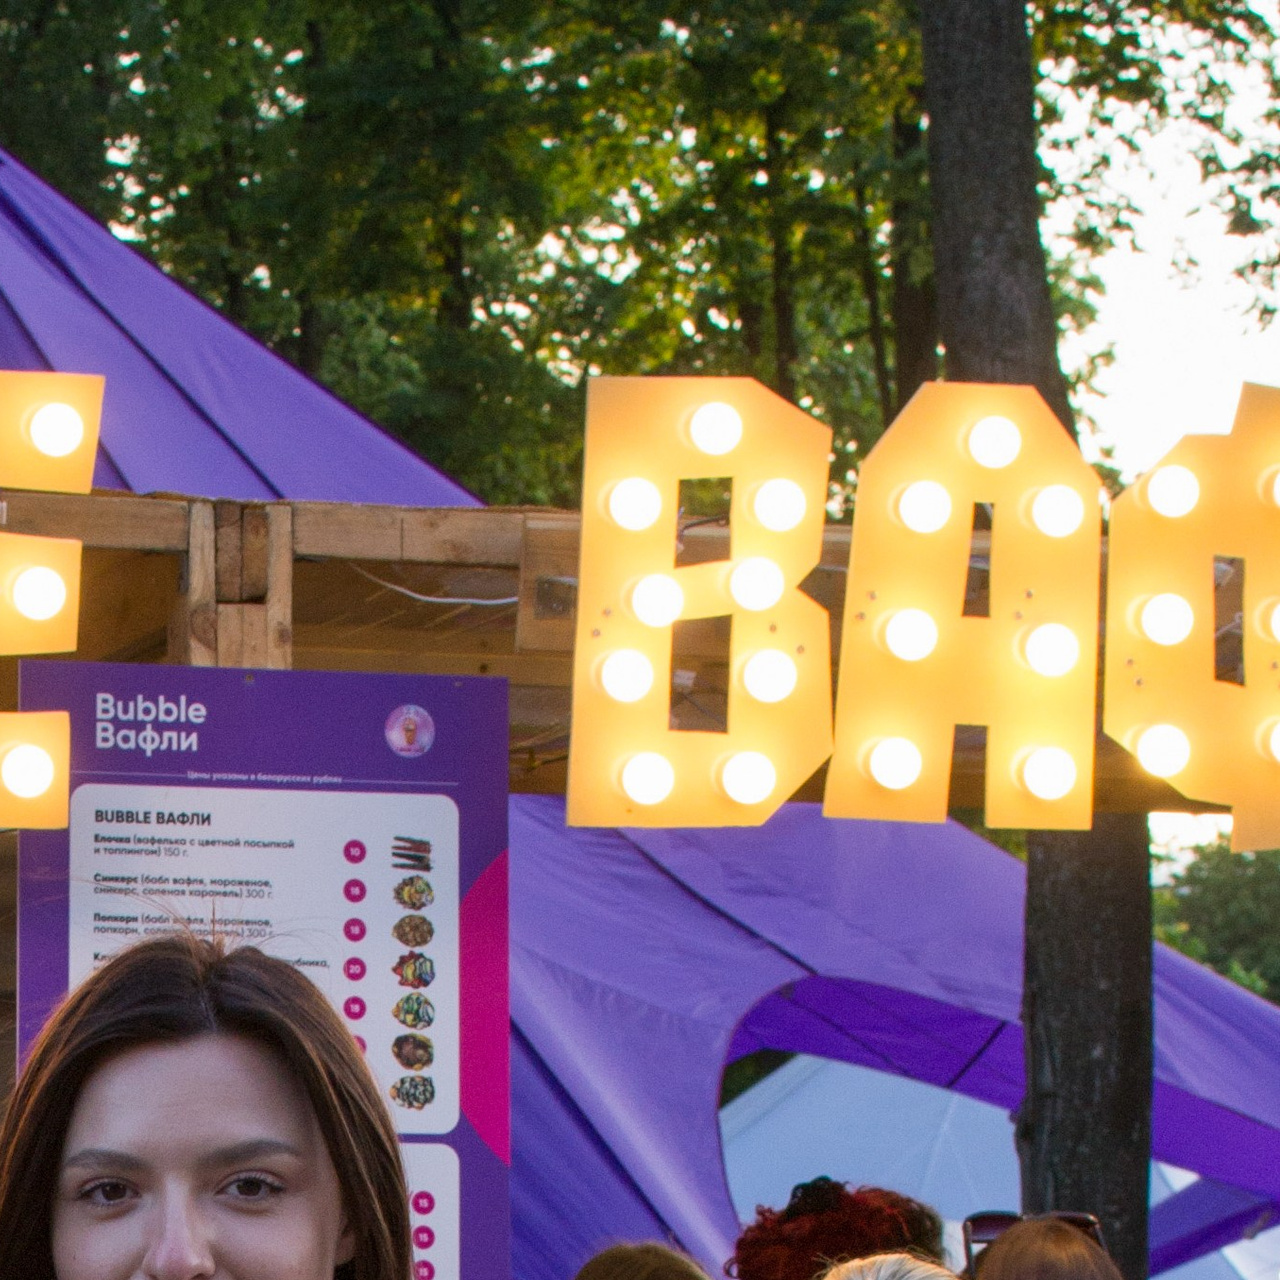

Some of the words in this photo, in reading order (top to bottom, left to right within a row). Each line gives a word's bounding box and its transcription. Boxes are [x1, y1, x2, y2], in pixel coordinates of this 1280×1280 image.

[95, 693, 207, 724] Bubble
[95, 723, 198, 757] Вафли
[95, 810, 152, 824] BUBBLE
[156, 811, 211, 826] ВАФЛИ
[197, 837, 241, 848] цветной
[243, 838, 295, 849] посыпкой
[103, 846, 161, 857] топпингом)
[164, 847, 180, 857] 150
[349, 846, 361, 857] 10
[141, 874, 170, 885] (бабл
[172, 876, 207, 887] вафля,
[210, 877, 273, 889] мороженое,
[189, 888, 243, 899] карамель)
[245, 889, 266, 899] 300
[94, 913, 138, 925] Попкорн
[141, 913, 170, 925] (бабл
[94, 925, 140, 936] попкорн,
[349, 965, 362, 975] 20
